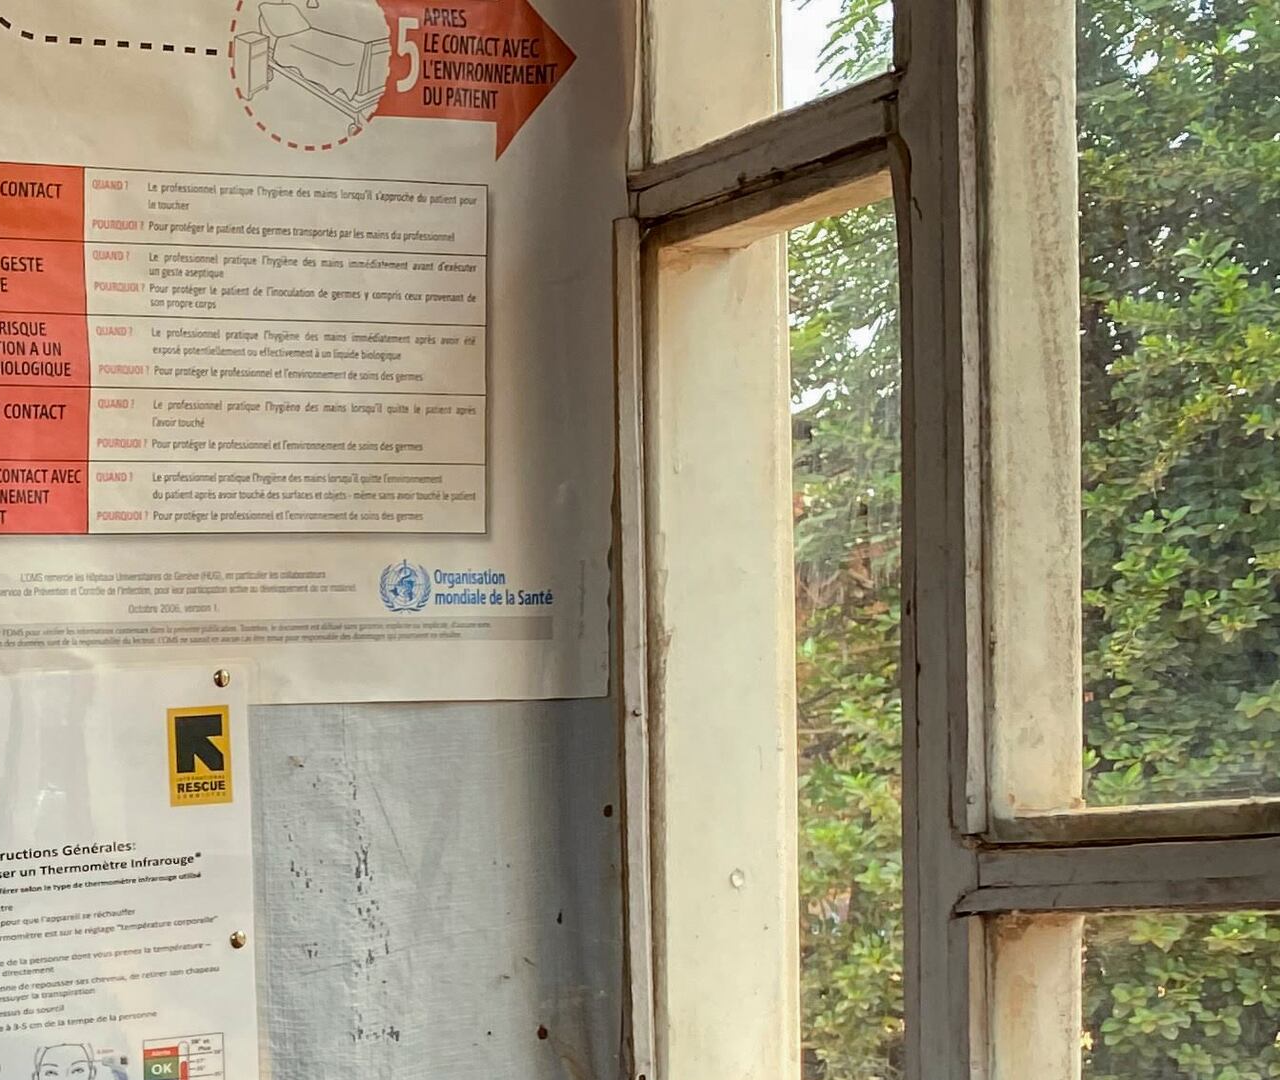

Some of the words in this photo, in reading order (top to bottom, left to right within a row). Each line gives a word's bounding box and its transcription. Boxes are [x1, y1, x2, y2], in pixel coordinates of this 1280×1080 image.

[424, 8, 467, 28] APRES
[424, 33, 438, 53] LE
[443, 34, 500, 57] CONTACT
[503, 38, 540, 58] AVEC
[396, 17, 420, 93] 5
[423, 60, 558, 84] L'ENVIRONNEMENT
[424, 87, 441, 106] DU
[446, 88, 498, 109] PATIENT
[0, 181, 62, 198] CONTACT
[1, 256, 44, 272] GESTE
[0, 321, 46, 337] RISQUE
[30, 342, 39, 355] A
[43, 342, 62, 356] UN
[4, 404, 66, 420] CONTACT
[51, 470, 81, 484] AVEC
[434, 569, 506, 588] Organisation
[435, 590, 486, 605] mondiale
[490, 591, 502, 605] de
[505, 590, 515, 605] la
[518, 589, 553, 605] Santé
[177, 780, 225, 793] RESCUE
[62, 842, 137, 856] Générales:
[20, 869, 36, 877] un
[40, 860, 127, 876] Thermomètre
[151, 1063, 172, 1075] OK
